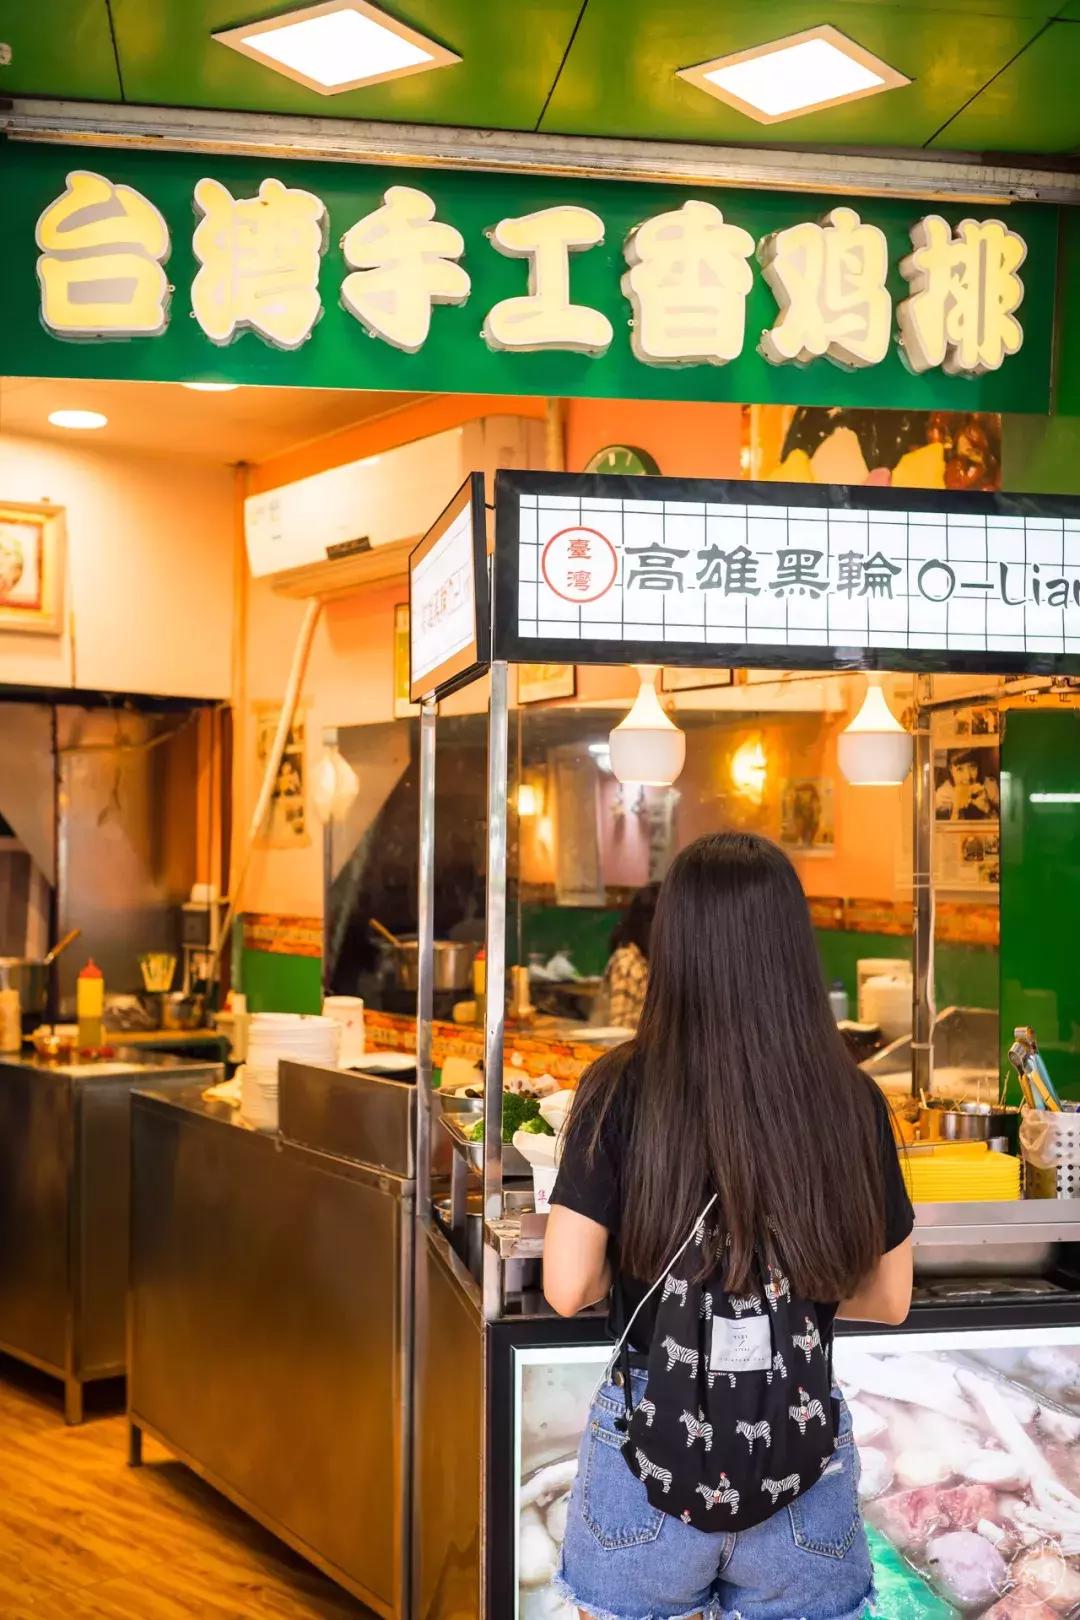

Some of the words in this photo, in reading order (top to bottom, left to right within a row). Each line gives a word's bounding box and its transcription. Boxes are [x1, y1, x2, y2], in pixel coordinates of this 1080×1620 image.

[35, 170, 1028, 376] 台湾手工香鸡排
[567, 539, 592, 591] 臺灣
[624, 542, 902, 600] 高雄黑輪
